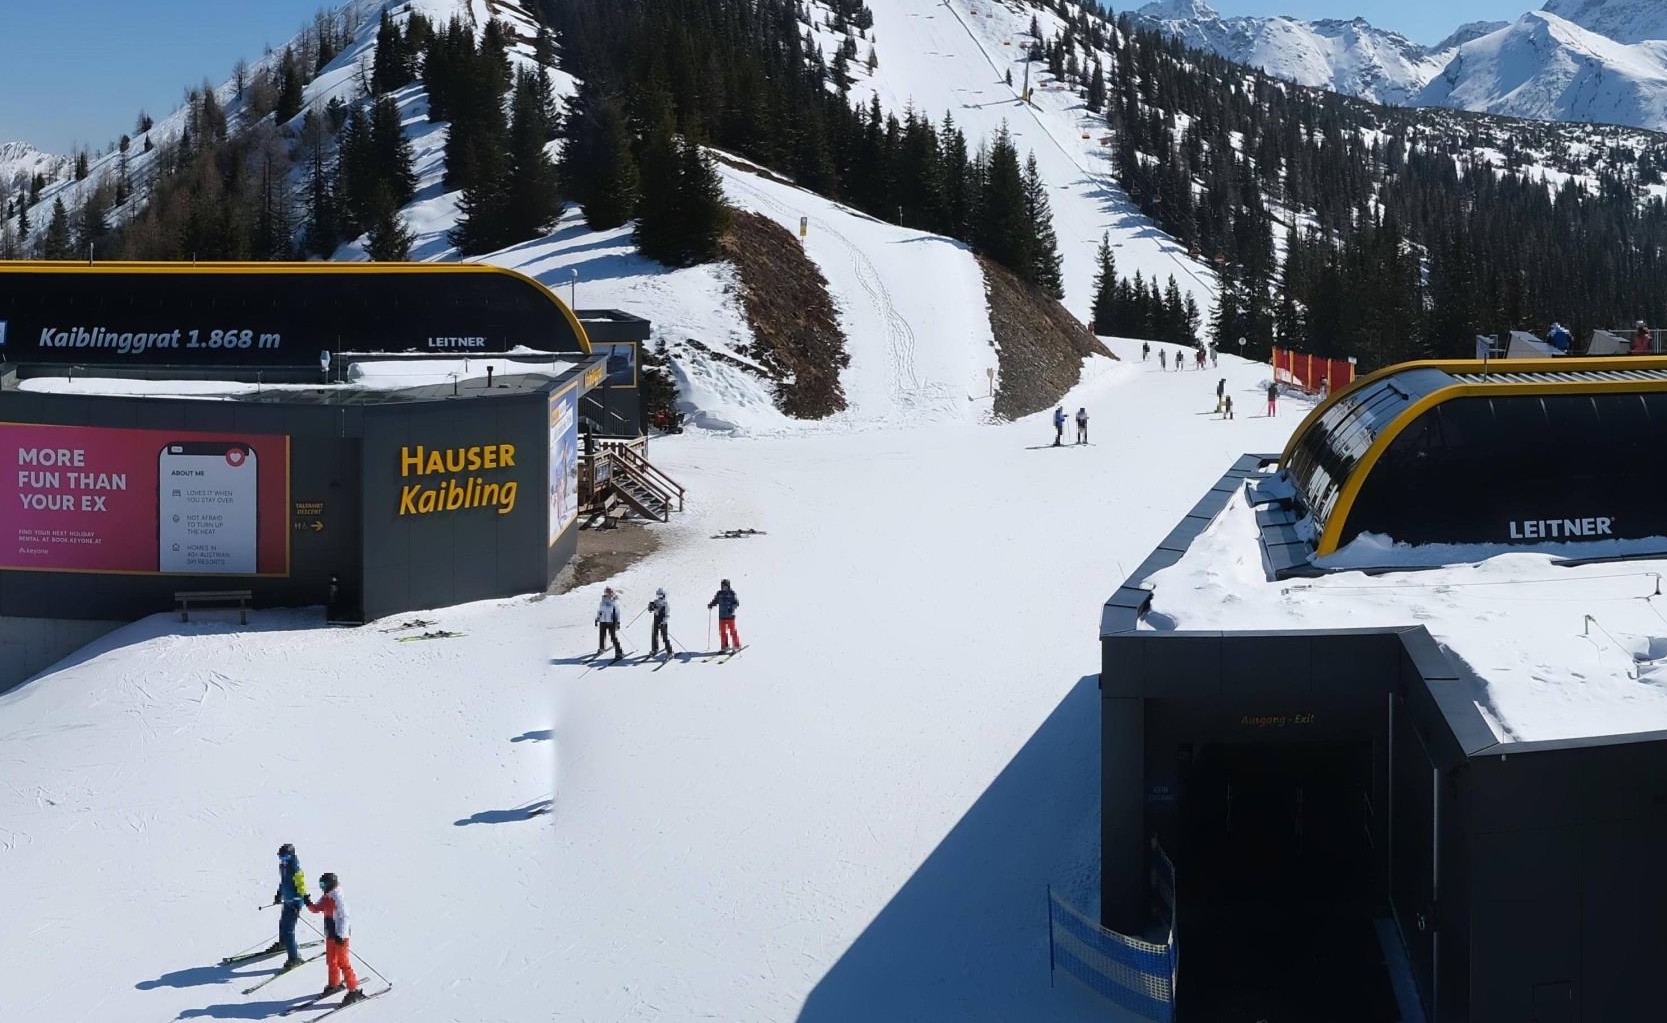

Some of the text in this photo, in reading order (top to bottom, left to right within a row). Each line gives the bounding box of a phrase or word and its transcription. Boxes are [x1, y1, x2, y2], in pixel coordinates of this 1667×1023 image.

[38, 327, 281, 354] Kaiblinggrat 1.868 m
[428, 337, 486, 347] LEITNER
[18, 448, 85, 467] MORE
[401, 444, 516, 477] HAUSER
[18, 471, 127, 491] FUN THAN
[19, 493, 107, 512] YOUR EX
[399, 477, 518, 515] Kaibling
[1509, 517, 1613, 539] LEITNER
[26, 547, 49, 556] keyone
[1240, 714, 1286, 727] Ausgang
[1294, 713, 1315, 724] Exit
